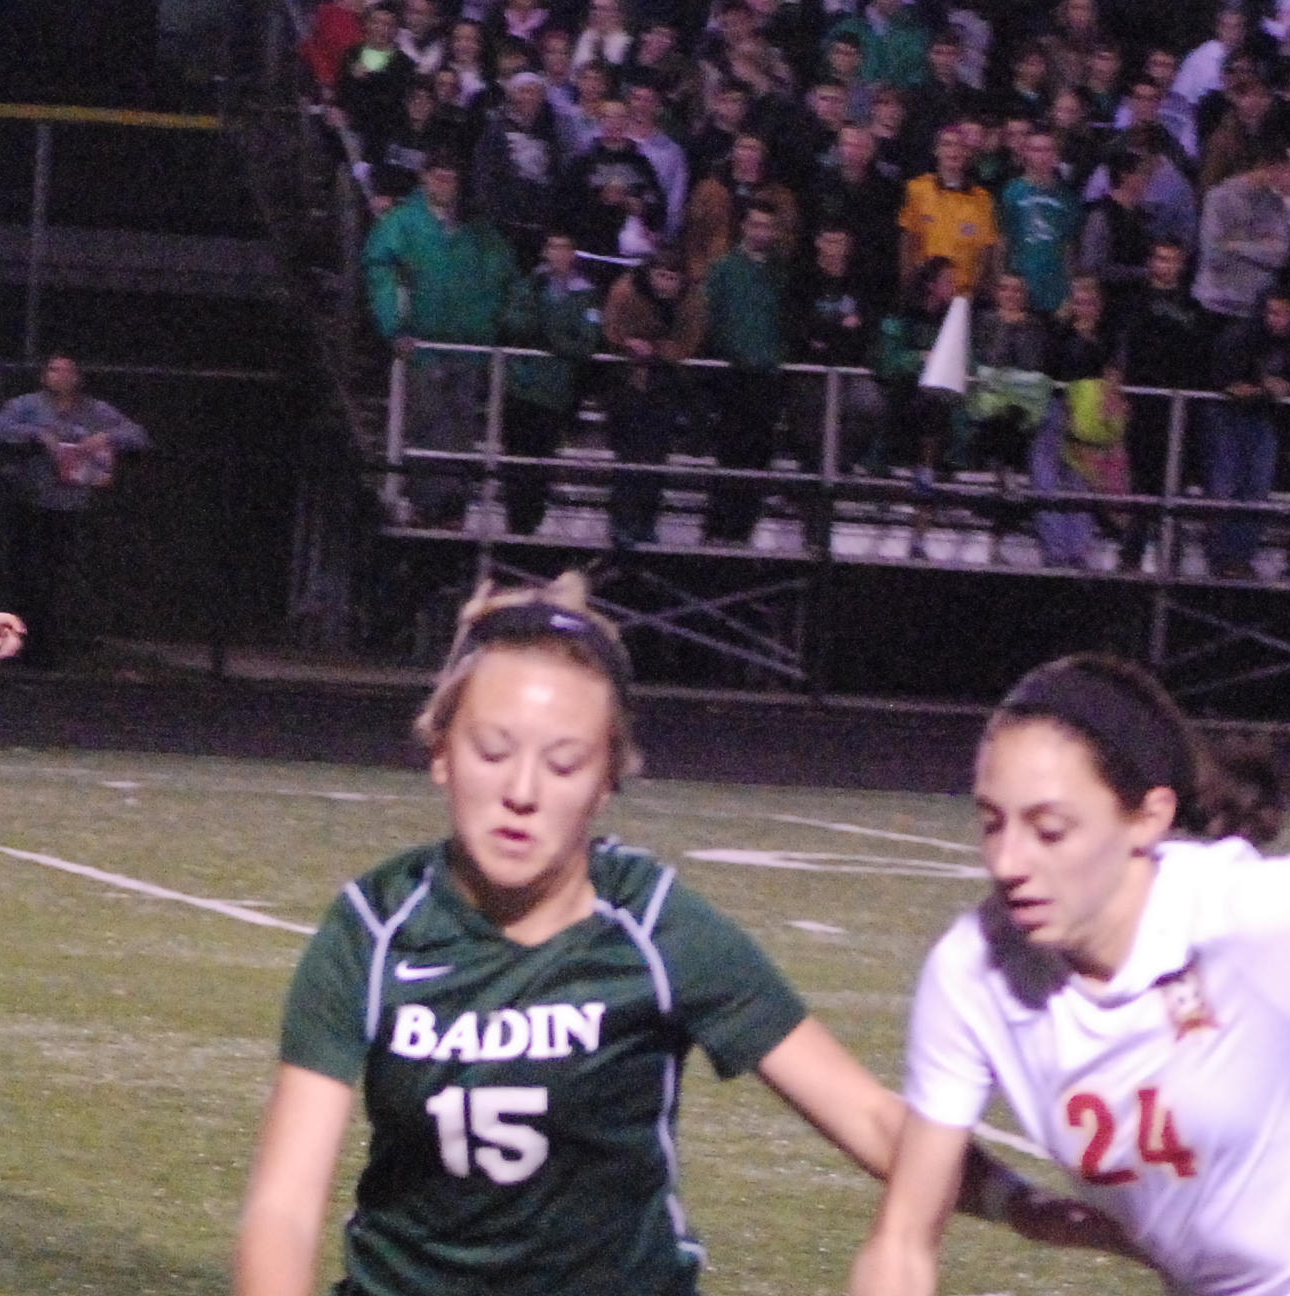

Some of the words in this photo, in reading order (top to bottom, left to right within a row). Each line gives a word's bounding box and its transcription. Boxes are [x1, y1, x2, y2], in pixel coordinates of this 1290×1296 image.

[390, 1002, 606, 1062] BADIN
[425, 1085, 550, 1185] 15
[1066, 1087, 1198, 1185] 24
